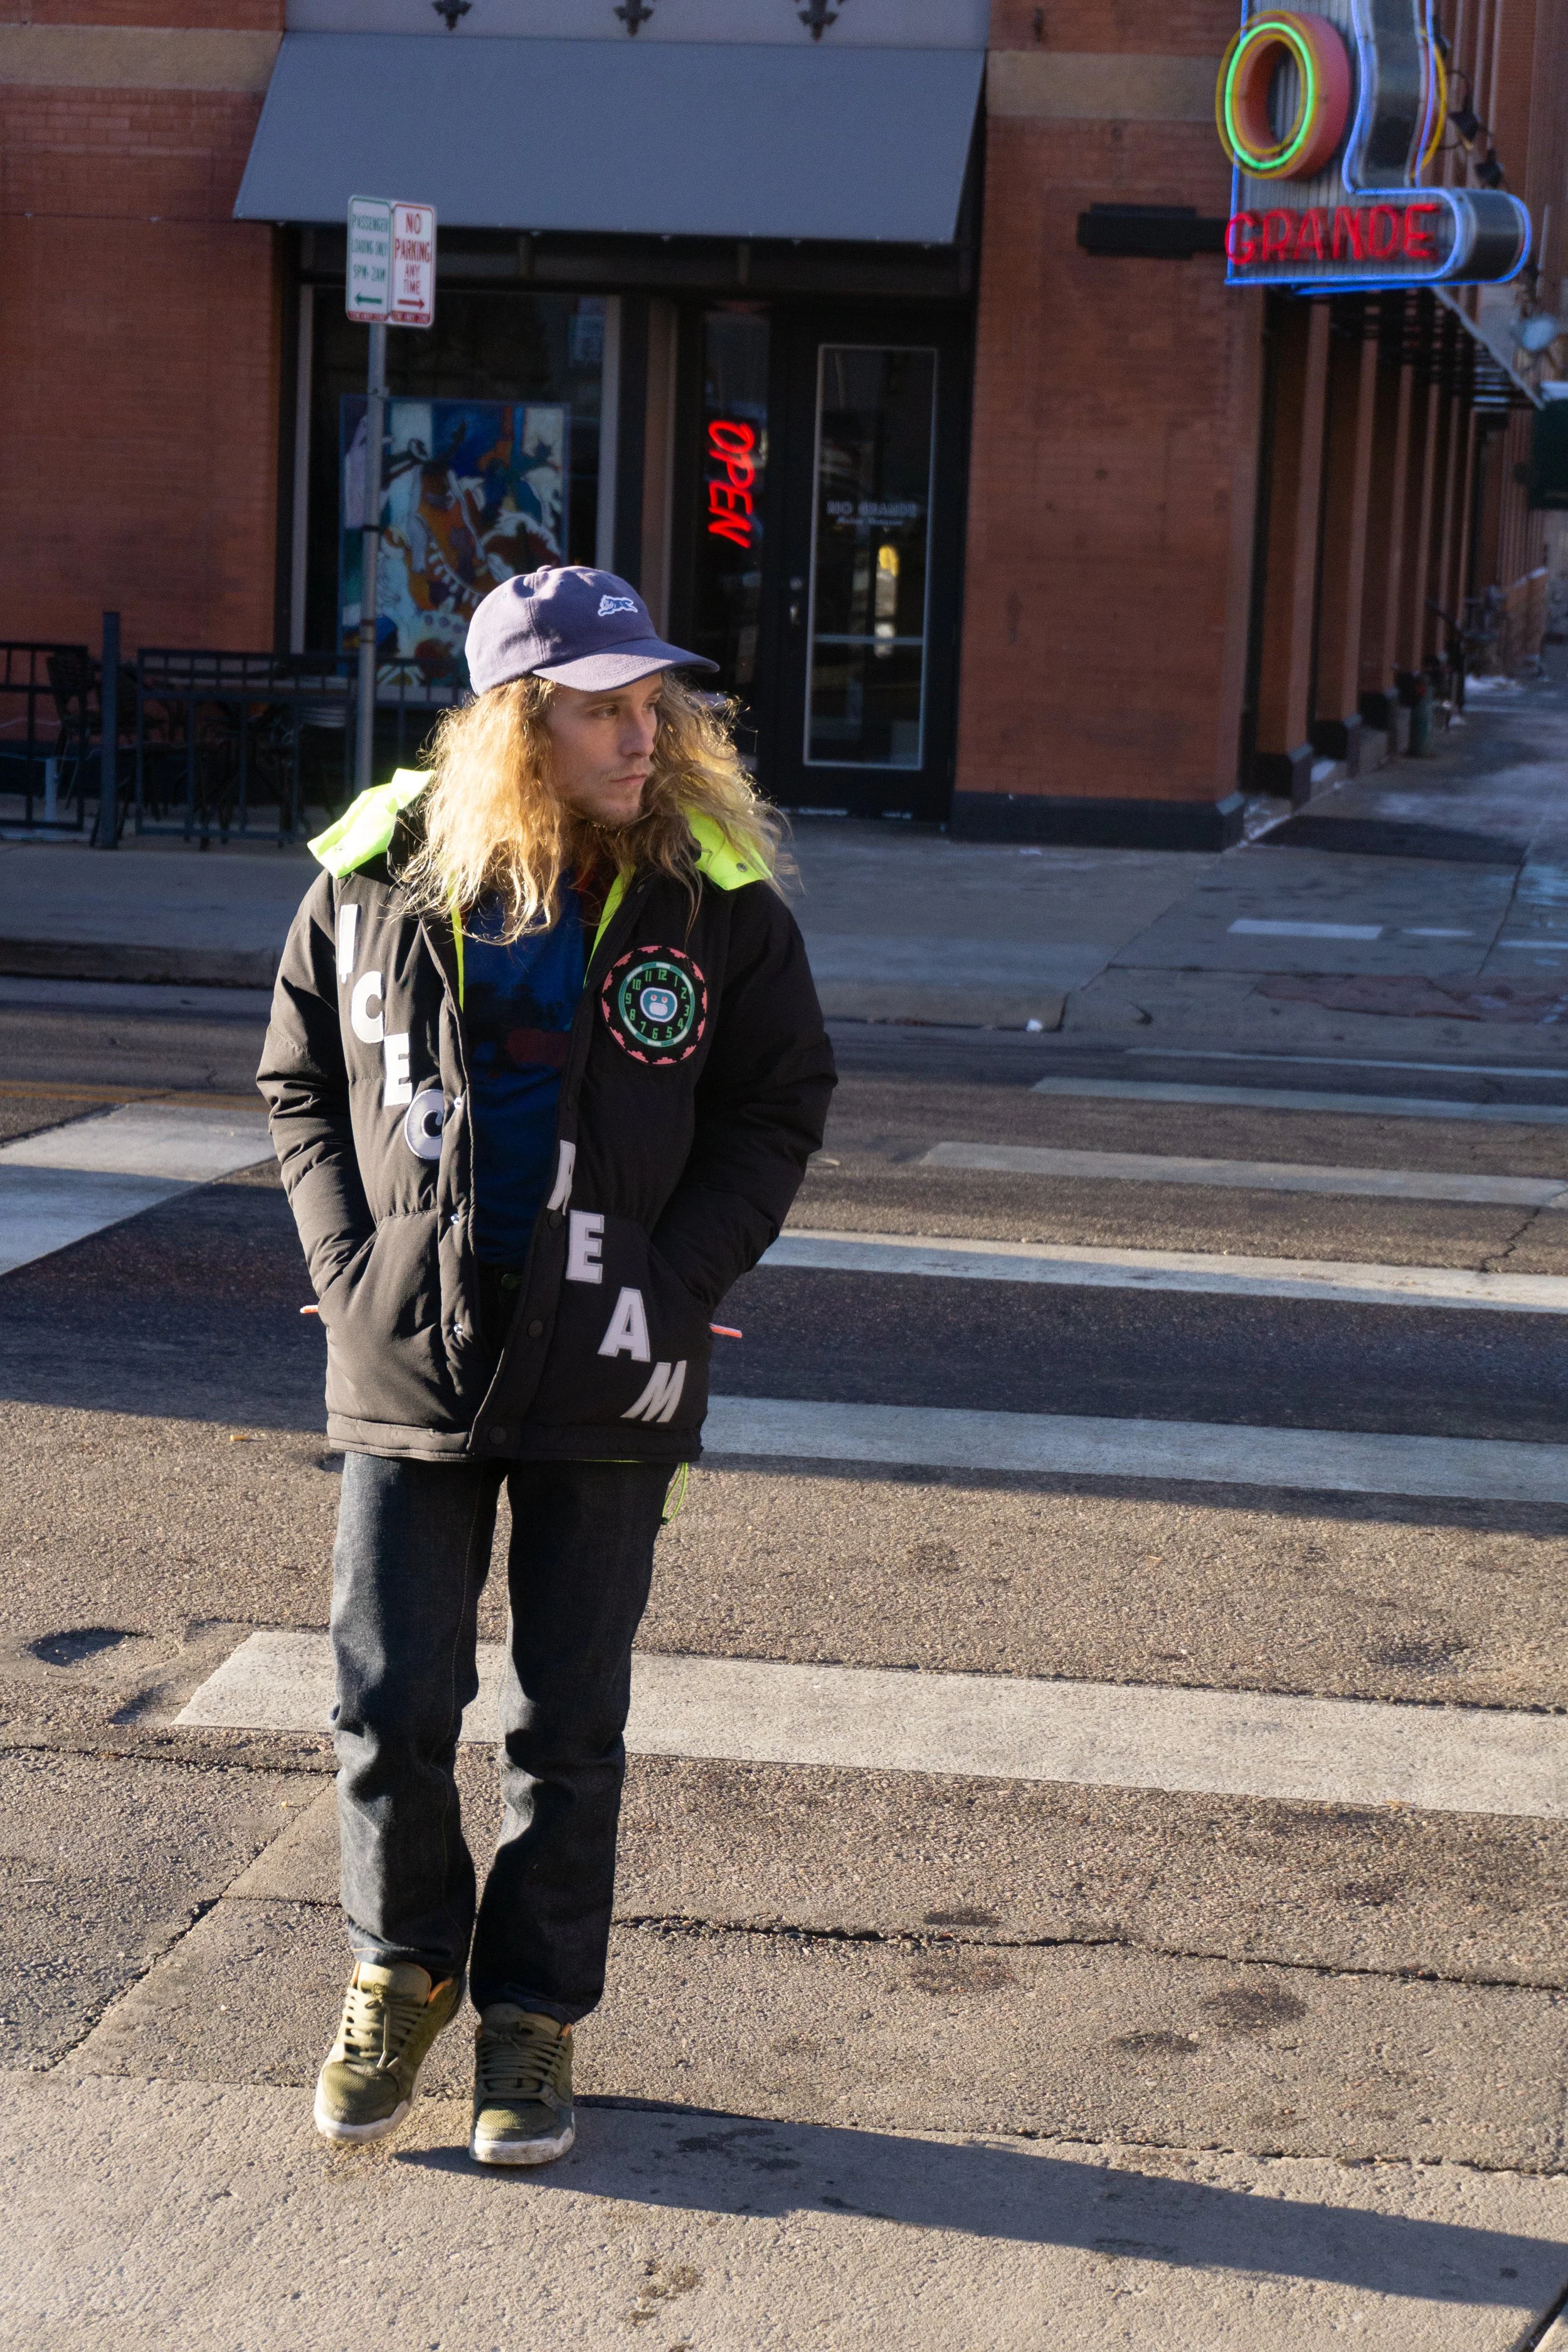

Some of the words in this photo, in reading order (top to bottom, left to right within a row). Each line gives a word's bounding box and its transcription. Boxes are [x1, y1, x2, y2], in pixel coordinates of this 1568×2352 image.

[352, 214, 389, 233] PASSENGER
[405, 212, 421, 235] NO
[1225, 203, 1440, 265] GRANDE
[395, 238, 430, 263] PARKING
[405, 263, 421, 278] ANY
[403, 278, 421, 295] TIME
[708, 420, 755, 549] OPEN
[827, 502, 854, 516] RIO
[645, 971, 652, 982] 11
[658, 969, 667, 981] 12
[632, 979, 641, 990] 10
[625, 993, 632, 1004] 9
[681, 987, 687, 999] 2
[629, 1009, 635, 1020] 8
[684, 1005, 690, 1016] 3
[640, 1021, 646, 1033] 7
[677, 1018, 684, 1029] 4
[652, 1028, 658, 1039] 6
[666, 1027, 672, 1039] 5
